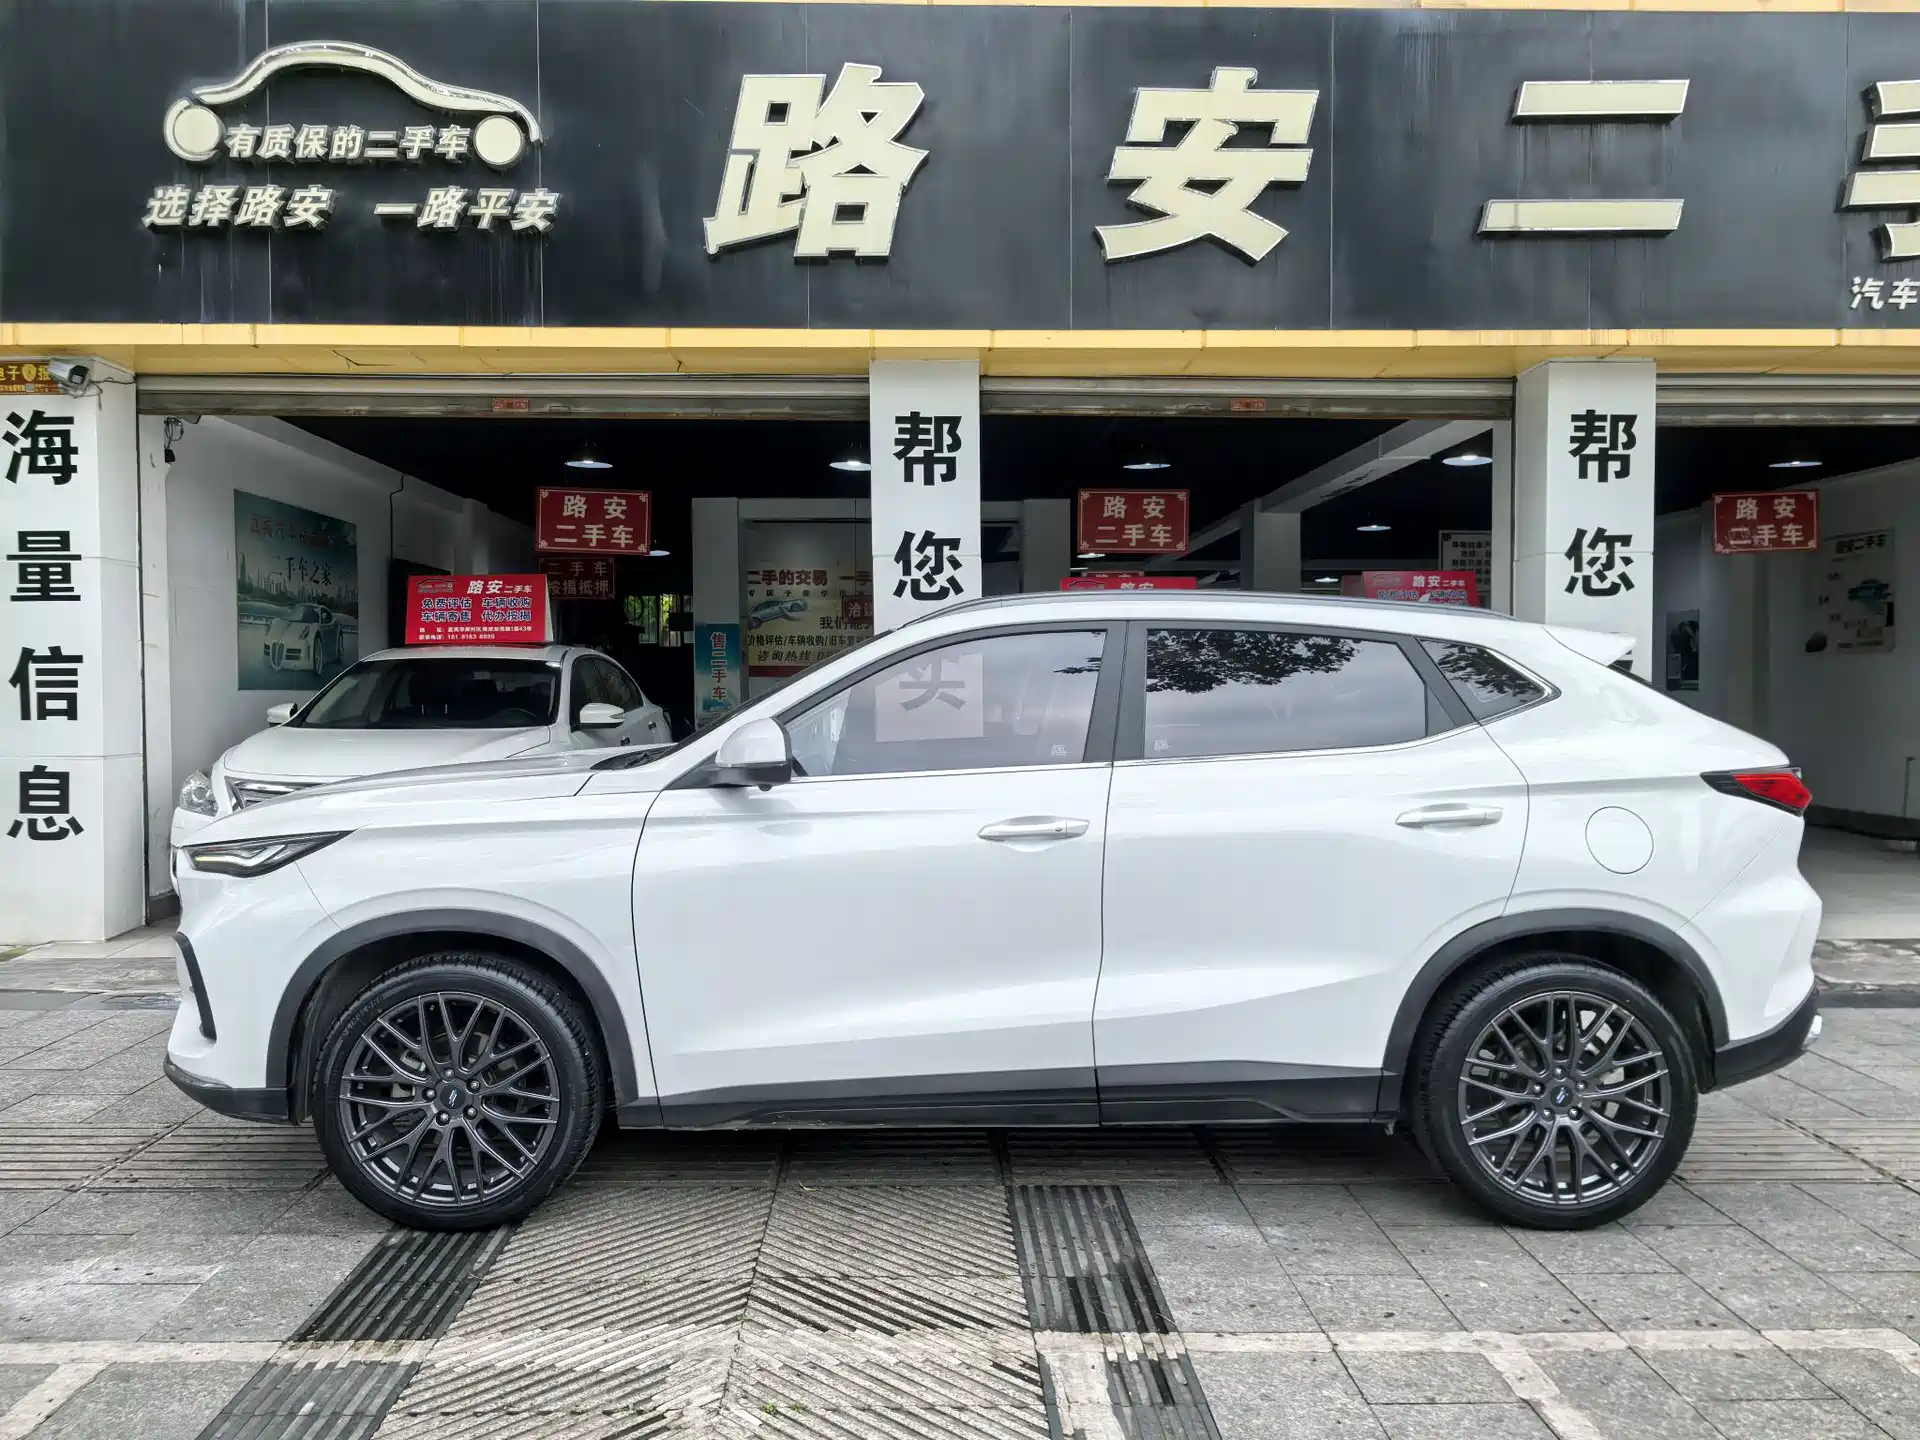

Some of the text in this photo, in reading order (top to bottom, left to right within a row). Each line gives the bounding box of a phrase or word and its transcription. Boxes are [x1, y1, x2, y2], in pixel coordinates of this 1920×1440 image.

[225, 124, 472, 161] 有质保的二手车
[145, 185, 560, 233] 选择路安 一路平安
[1850, 276, 1920, 311] 汽车
[563, 494, 628, 520] 路安
[1103, 496, 1167, 519] 路安
[1736, 496, 1796, 520] 路安
[554, 523, 635, 548] 二手车
[1095, 524, 1173, 547] 二手车
[1564, 409, 1637, 672] 帮您
[1729, 523, 1804, 547] 二手车
[547, 561, 608, 577] 二手车
[747, 570, 828, 586] 二手的交易
[422, 597, 532, 609] 免费评估 车辆收购
[2, 409, 84, 841] 海量信息
[421, 610, 532, 622] 车辆寄售 代办按揭
[710, 632, 728, 700] 售二手车
